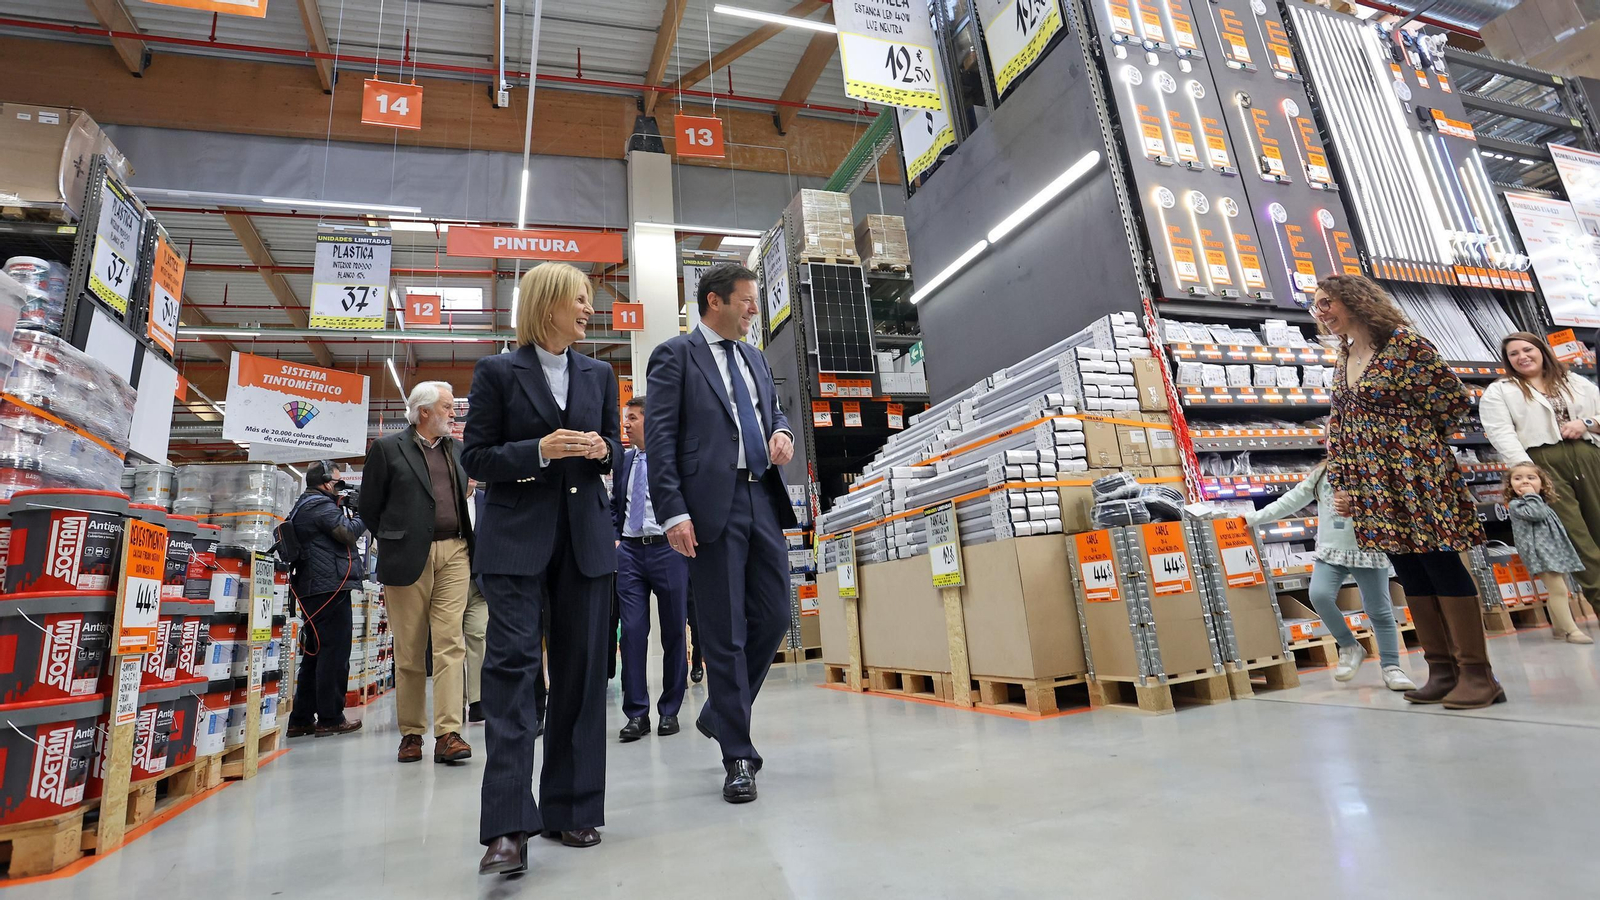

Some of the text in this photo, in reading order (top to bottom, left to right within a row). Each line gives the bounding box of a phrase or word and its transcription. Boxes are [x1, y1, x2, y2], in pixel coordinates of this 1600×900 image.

[854, 2, 881, 18] ESTANCA
[882, 9, 893, 20] LED
[866, 19, 903, 34] LUZ NEUTRA
[376, 94, 410, 116] 14
[685, 128, 714, 146] 13
[1554, 152, 1600, 166] BOMBILLA RECOMEN
[1512, 202, 1540, 212] BOMBILLAS
[332, 244, 374, 260] PLASTICA
[493, 236, 580, 253] PINTURA
[108, 252, 126, 287] 37
[342, 286, 370, 312] 37
[412, 302, 434, 316] 12
[620, 310, 637, 323] 11
[280, 365, 327, 381] SISTEMA
[262, 374, 342, 395] TINTOMÉTRICO
[274, 436, 297, 445] calidad
[298, 439, 332, 448] profesional
[293, 432, 315, 440] colores
[316, 434, 349, 444] disponibles
[88, 520, 122, 532] Antigo
[54, 516, 87, 583] SOETAM
[82, 622, 107, 632] Antig
[48, 620, 81, 690] SOETAM
[179, 621, 200, 673] SOETAM
[39, 727, 74, 803] SOETAM
